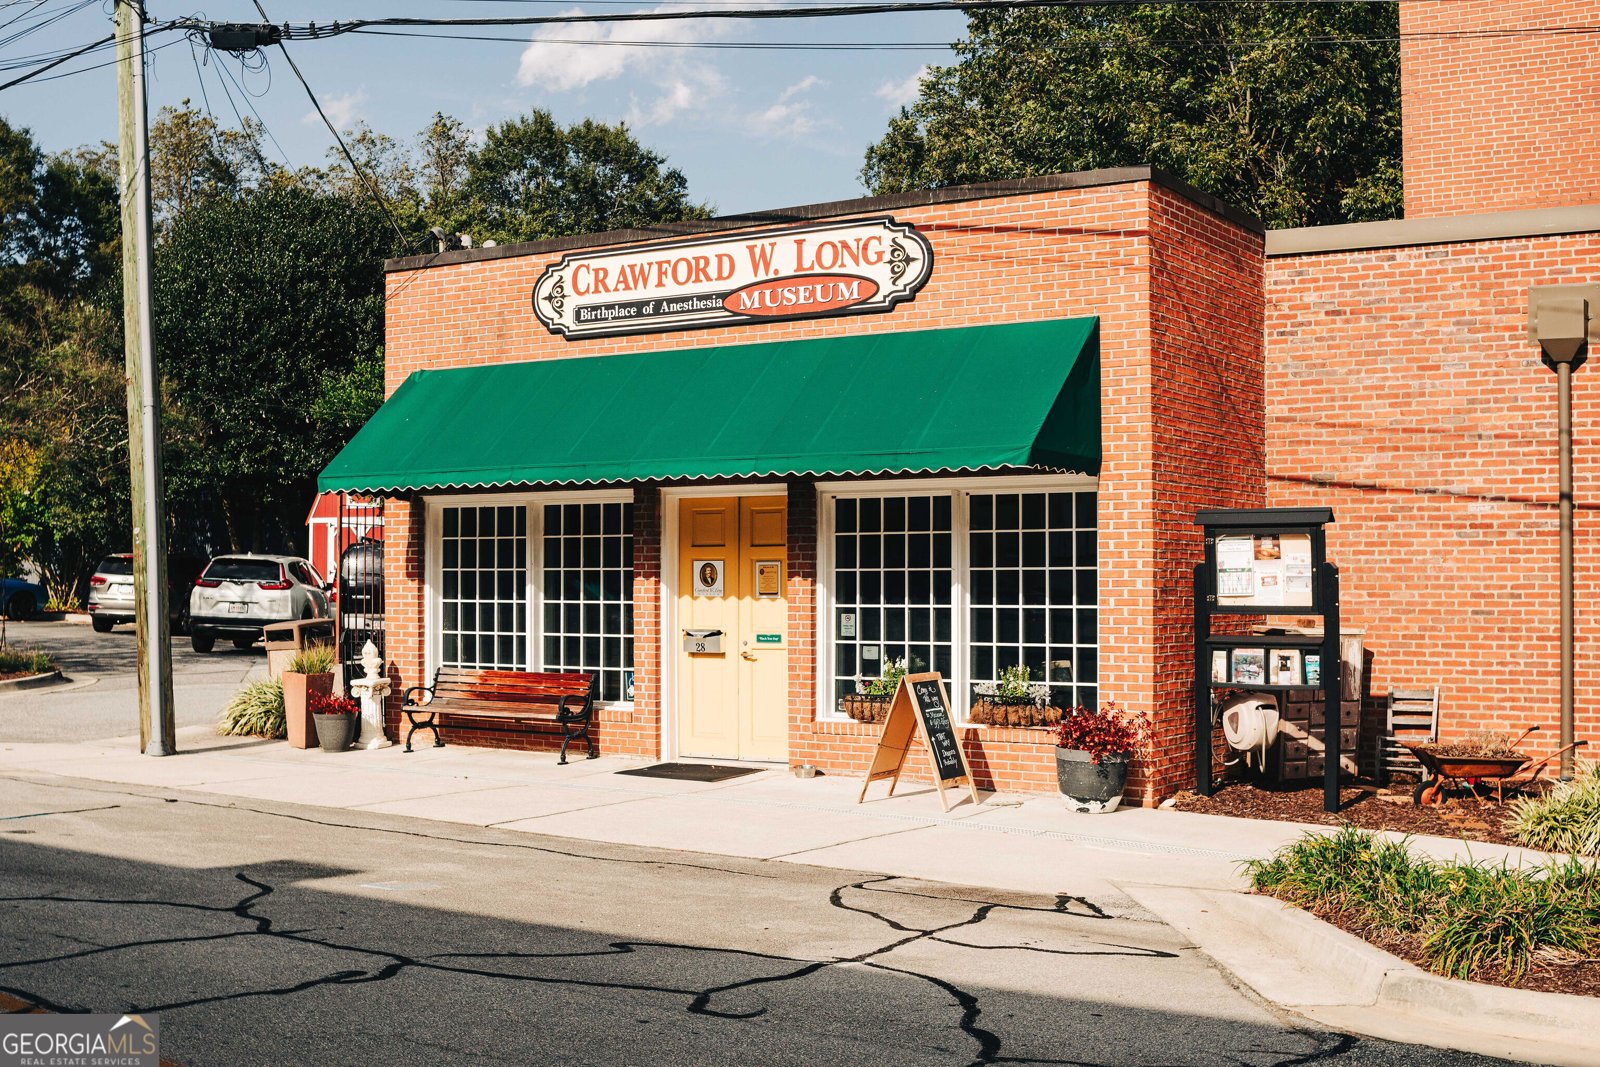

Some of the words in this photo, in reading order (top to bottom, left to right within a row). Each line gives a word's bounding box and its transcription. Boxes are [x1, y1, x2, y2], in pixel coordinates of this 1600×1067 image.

[570, 253, 736, 297] CRAWFORD
[745, 241, 780, 277] W.
[794, 235, 886, 274] LONG
[578, 303, 638, 322] Birthplace
[642, 301, 655, 316] of
[659, 295, 724, 313] Anesthesia
[738, 279, 862, 311] MUSEUM
[695, 642, 706, 652] 28
